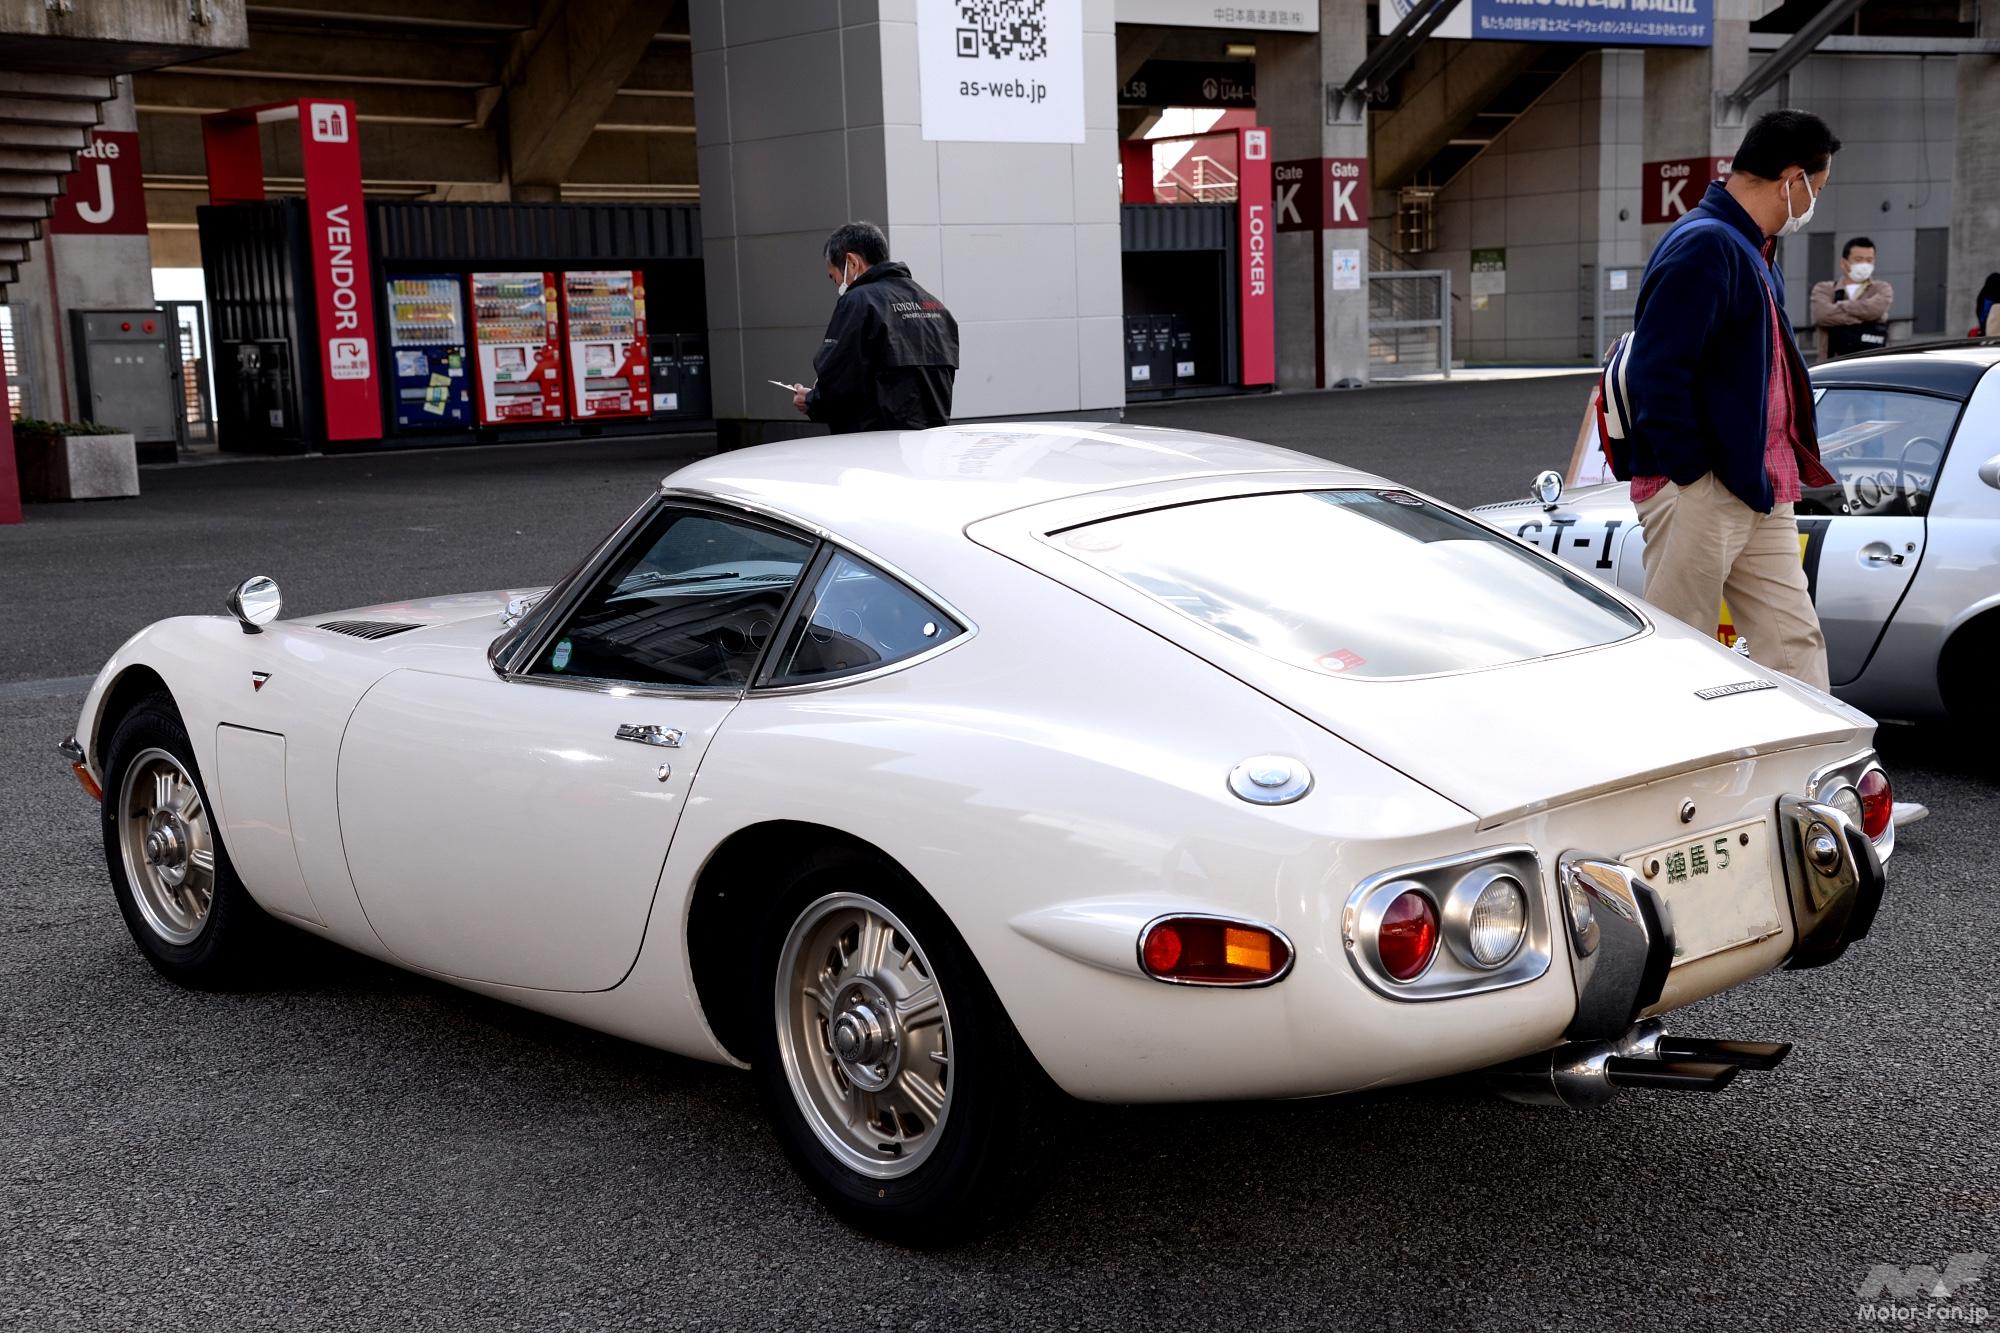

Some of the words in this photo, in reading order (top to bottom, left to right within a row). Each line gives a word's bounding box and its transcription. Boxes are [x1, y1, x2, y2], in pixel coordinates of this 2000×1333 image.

[960, 79, 1046, 103] as-web.jp
[77, 139, 119, 158] ate
[1275, 166, 1303, 180] Gate
[1331, 162, 1359, 177] Gate
[1660, 164, 1690, 178] Gate
[75, 164, 114, 223] J
[1277, 183, 1303, 225] K
[1333, 180, 1359, 222] K
[1661, 179, 1688, 216] K
[1250, 205, 1265, 297] LOCKER
[326, 204, 357, 330] VENDOR
[891, 301, 922, 312] TOYOTA
[1713, 838, 1730, 869] 5
